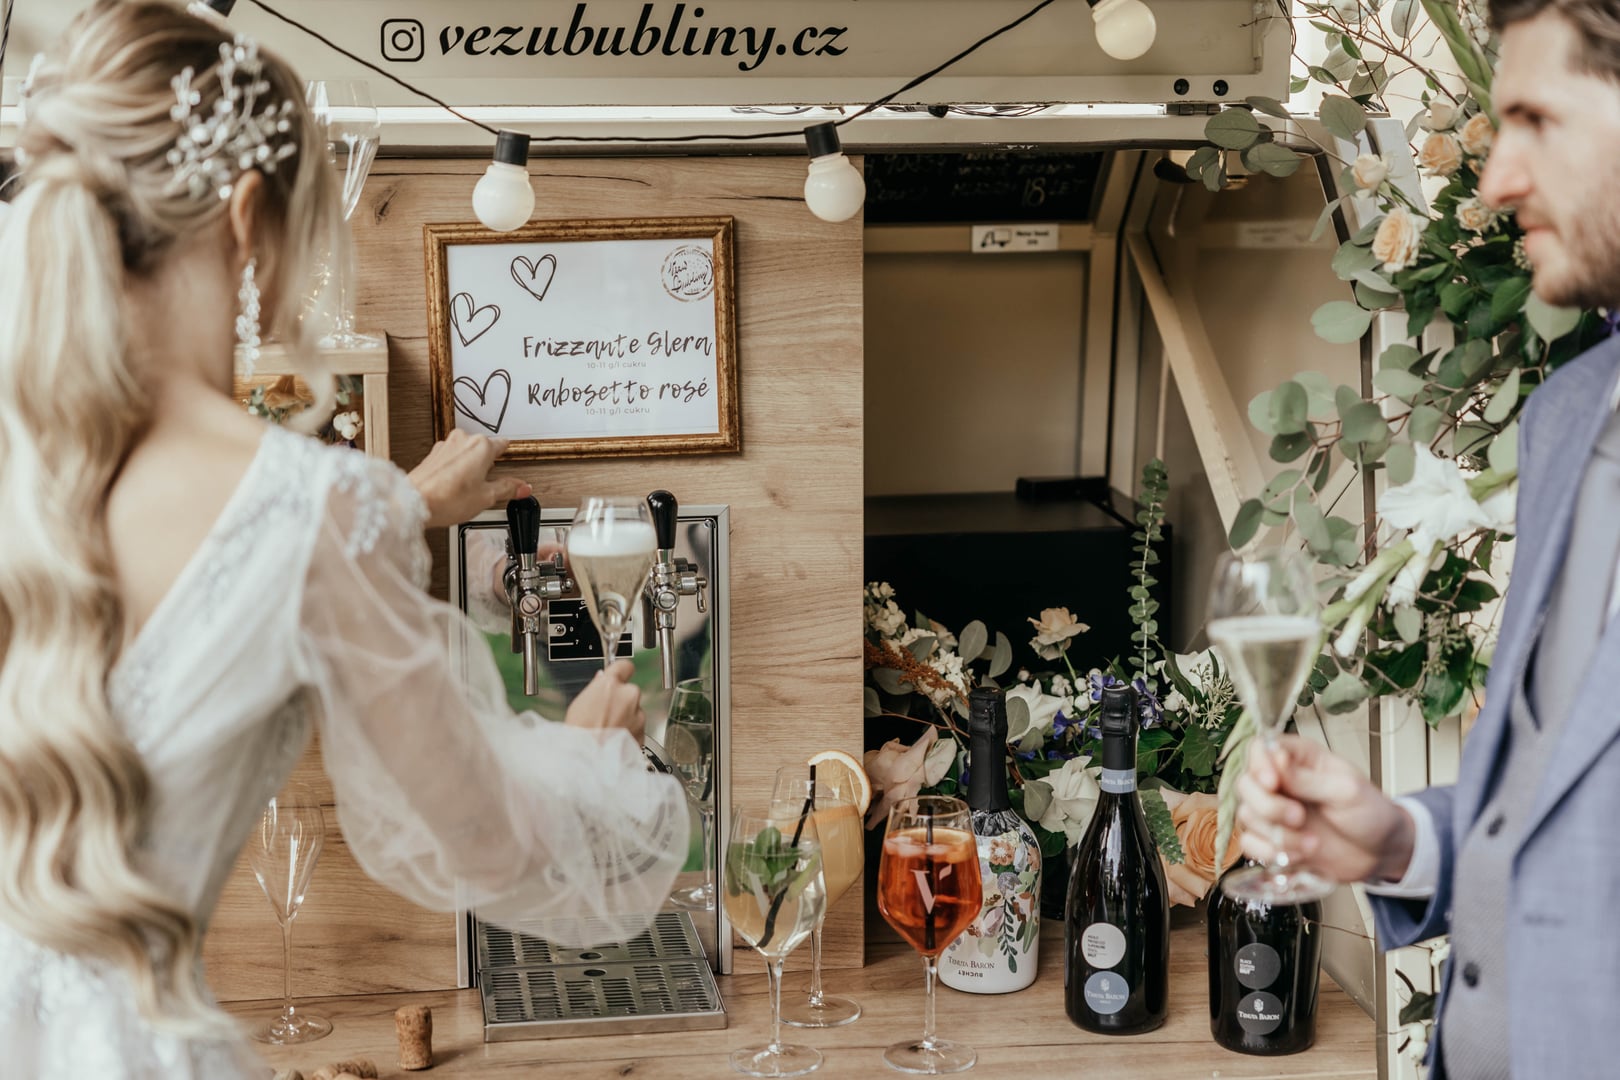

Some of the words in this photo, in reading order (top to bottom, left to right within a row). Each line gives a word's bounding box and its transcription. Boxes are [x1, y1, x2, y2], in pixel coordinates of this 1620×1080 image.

[438, 3, 848, 71] vezububliny.cz
[523, 334, 641, 360] Frizzante
[647, 330, 713, 357] Glera
[586, 361, 606, 369] 10-11
[622, 360, 647, 369] cukru
[527, 377, 653, 408] Rabosetto
[659, 377, 710, 403] rosé
[586, 407, 606, 415] 10-11
[624, 406, 650, 415] cukru
